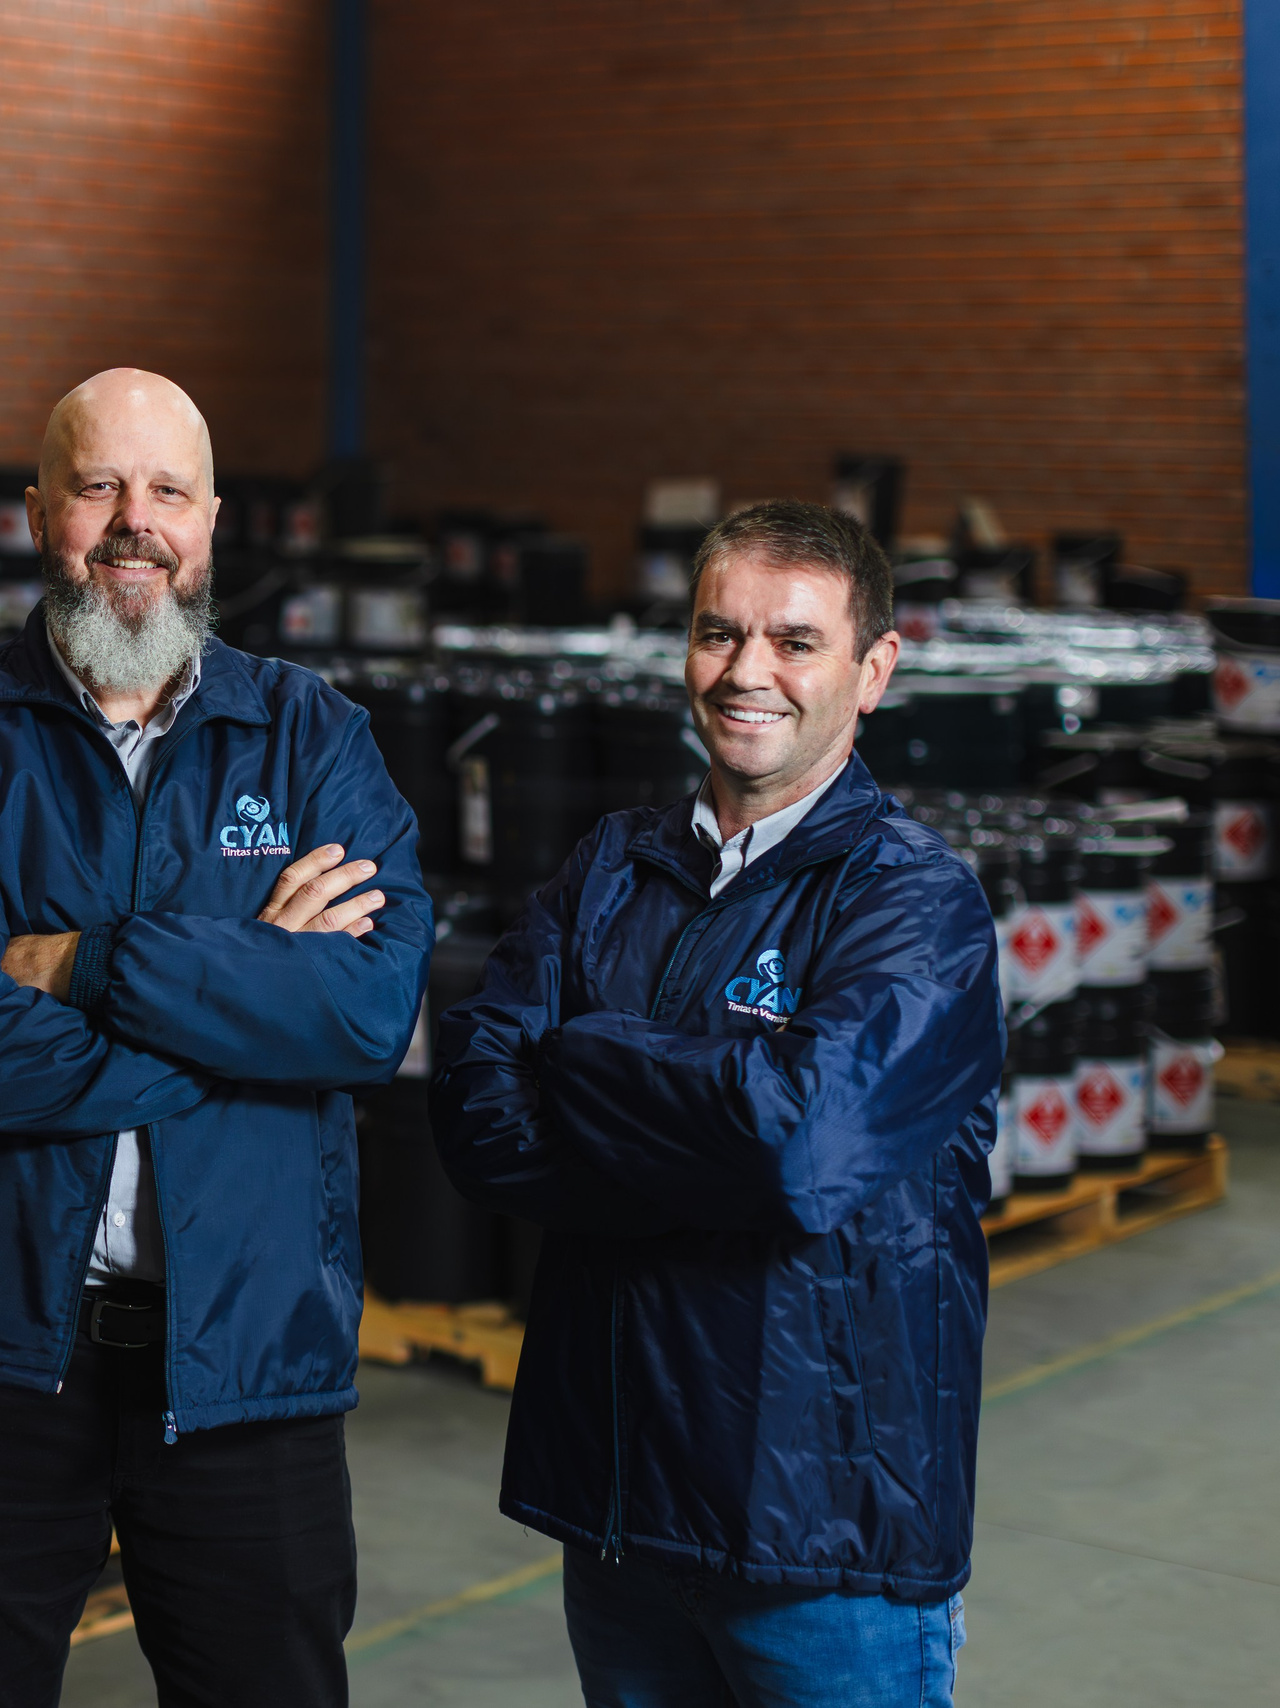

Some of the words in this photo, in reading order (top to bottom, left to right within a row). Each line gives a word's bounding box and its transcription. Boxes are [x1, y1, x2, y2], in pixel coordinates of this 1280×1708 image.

[220, 822, 289, 848] CYAN
[221, 847, 251, 857] Tintas
[253, 848, 260, 856] e
[724, 975, 803, 1015] CYAN
[727, 1000, 752, 1014] Tintas
[752, 1007, 758, 1015] e
